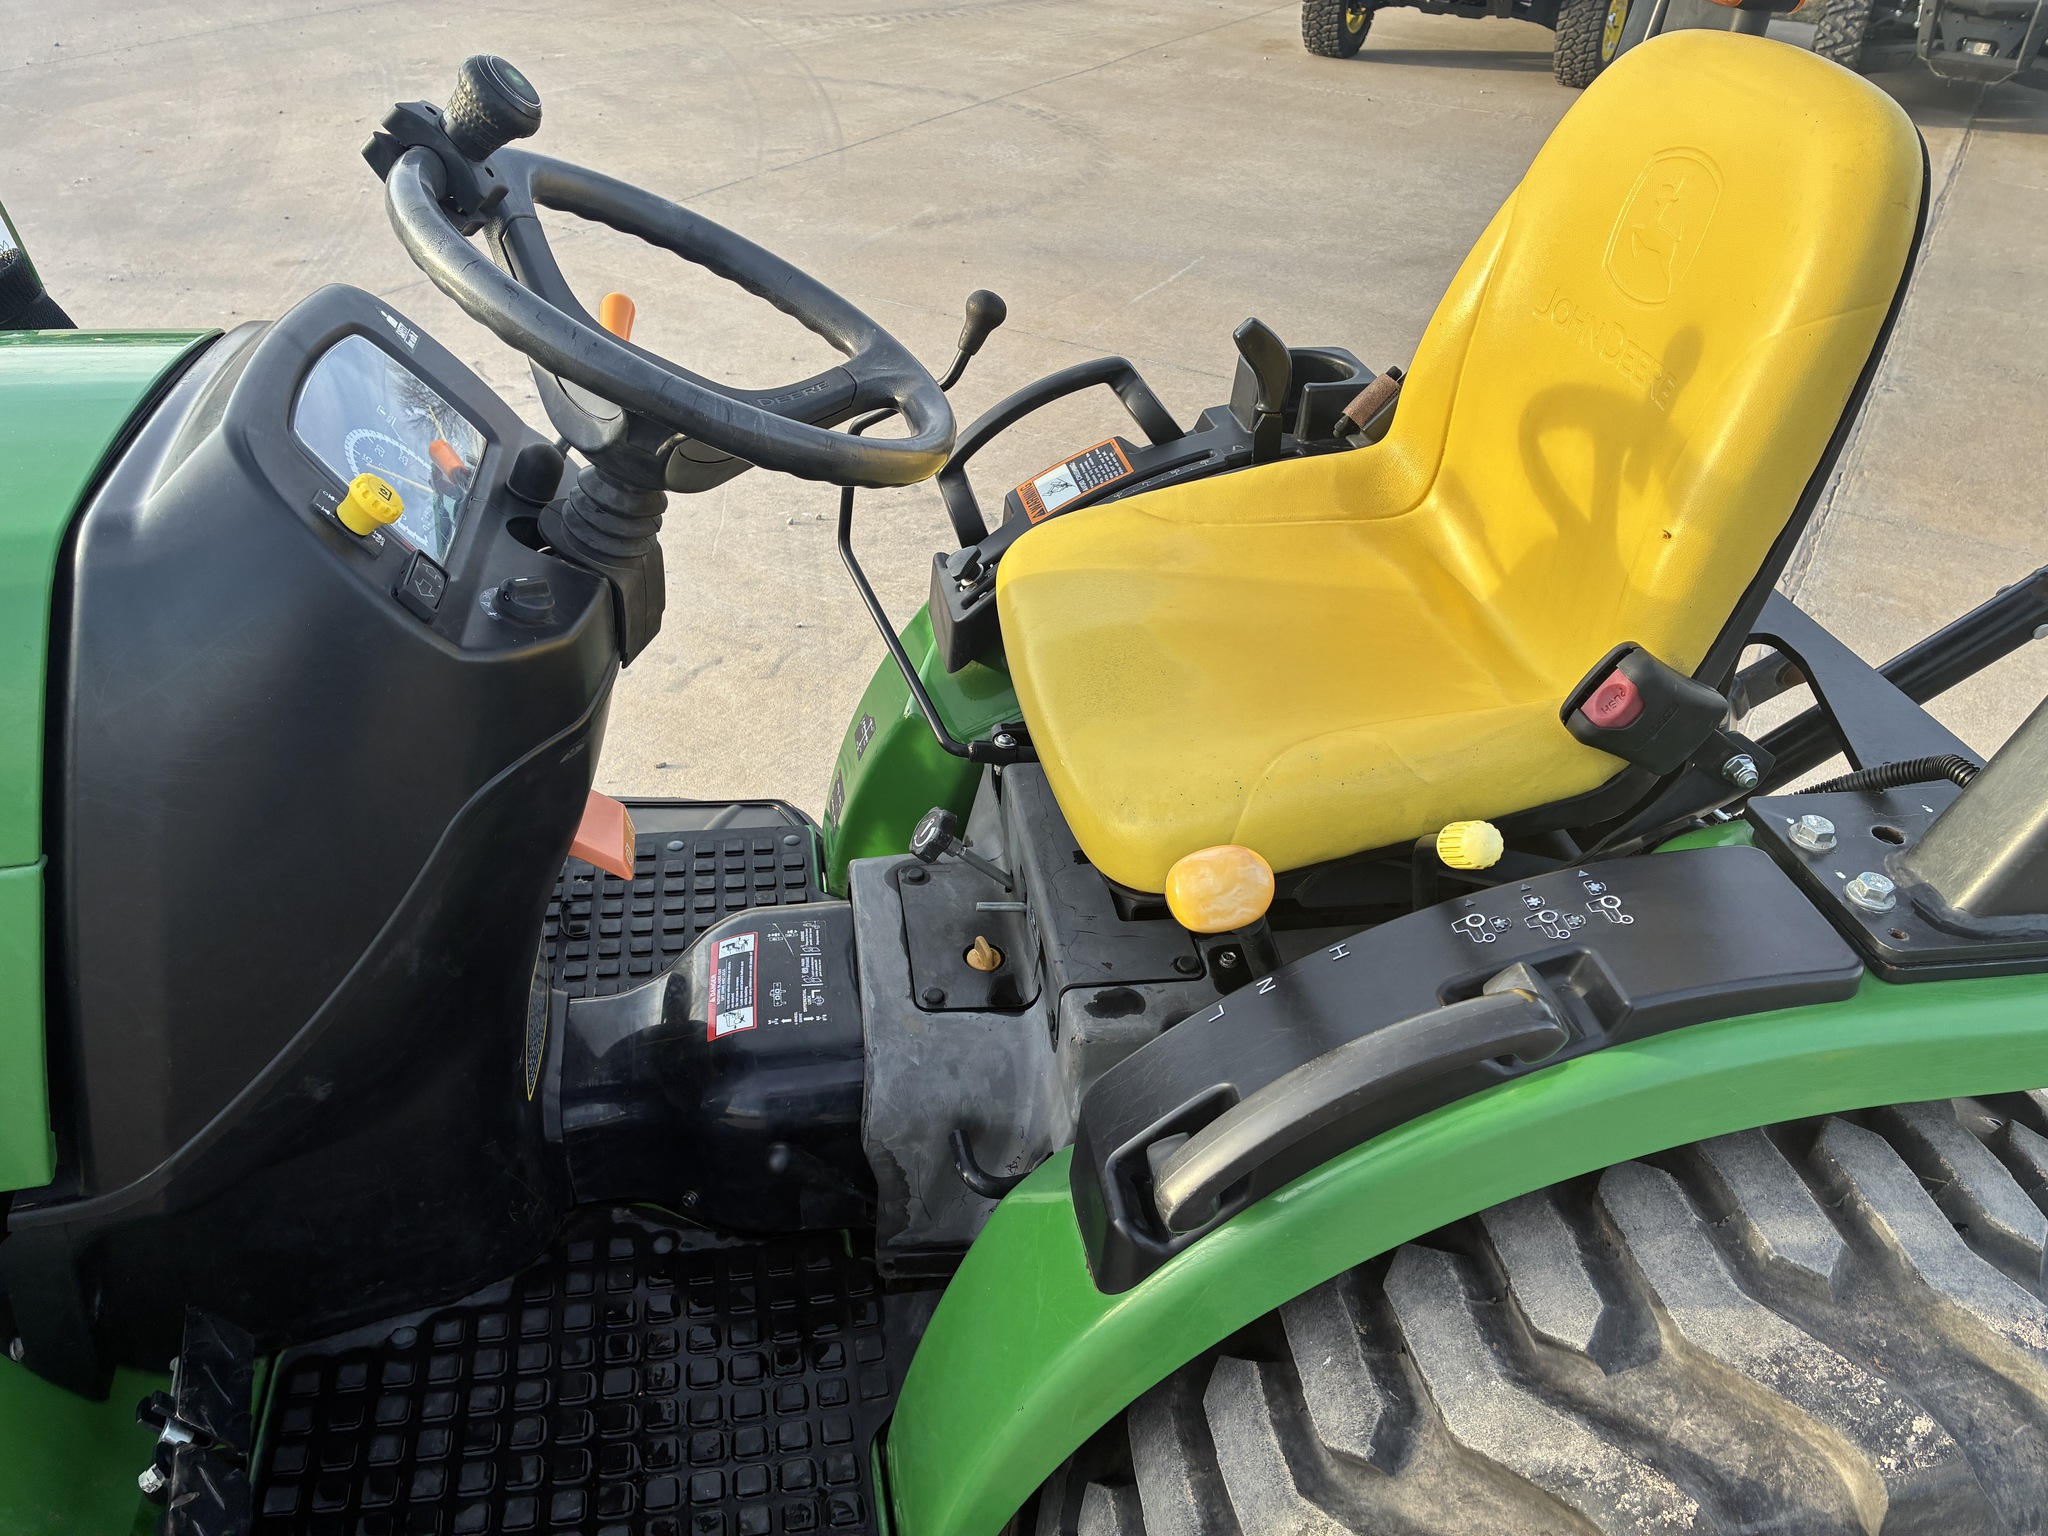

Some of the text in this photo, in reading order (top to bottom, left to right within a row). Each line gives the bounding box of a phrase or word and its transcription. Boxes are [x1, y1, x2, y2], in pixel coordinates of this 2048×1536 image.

[1532, 286, 1678, 411] JOHN DEERE
[757, 380, 831, 407] DEERE
[1019, 482, 1043, 514] WARNING
[1601, 687, 1627, 715] PUSH
[1328, 943, 1351, 961] H
[1256, 976, 1277, 995] N
[1208, 1004, 1225, 1023] L
